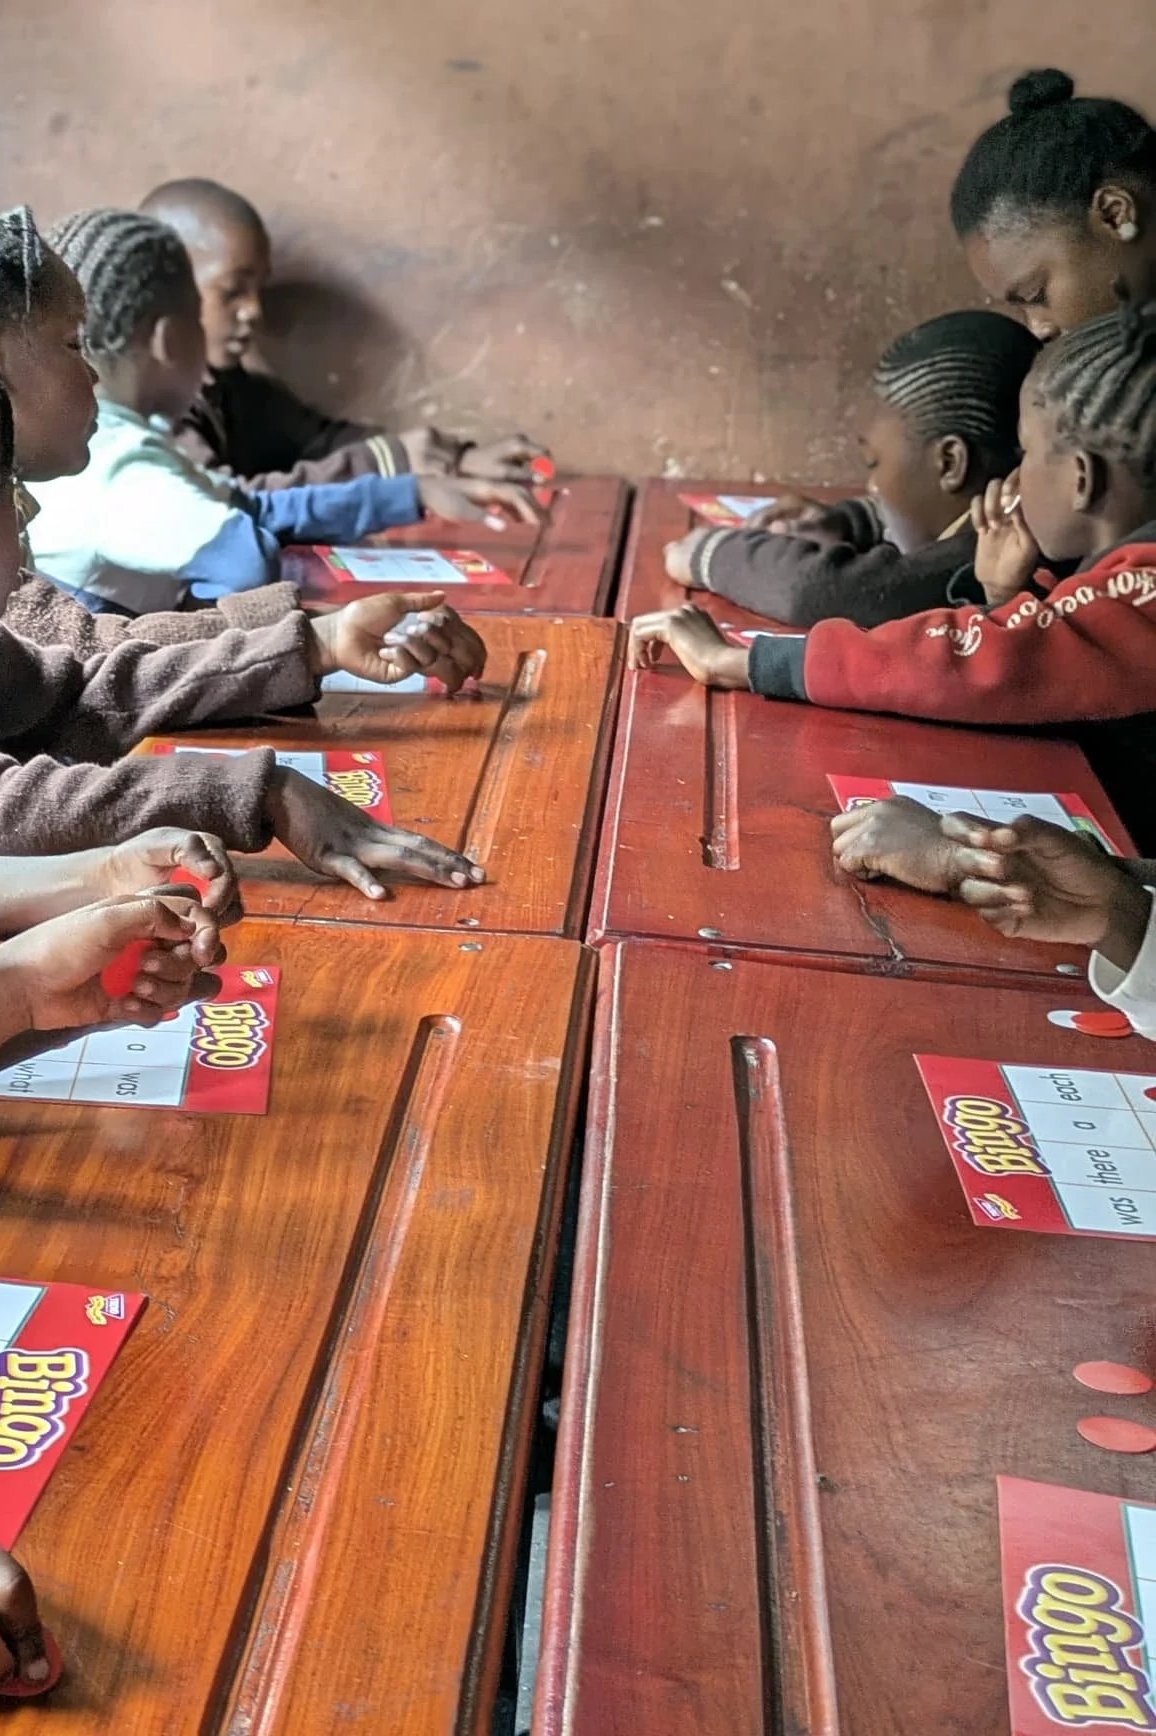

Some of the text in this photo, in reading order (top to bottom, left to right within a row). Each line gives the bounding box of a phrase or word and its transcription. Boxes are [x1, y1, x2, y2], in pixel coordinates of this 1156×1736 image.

[127, 1043, 147, 1052] a
[194, 1002, 266, 1068] Bingo
[8, 1062, 45, 1093] what
[116, 1072, 141, 1096] was
[1038, 1073, 1082, 1102] each
[946, 1097, 1050, 1175] Bingo
[1073, 1120, 1096, 1130] a
[1087, 1149, 1124, 1185] there
[1110, 1196, 1144, 1226] was
[1020, 1566, 1154, 1729] Bingo
